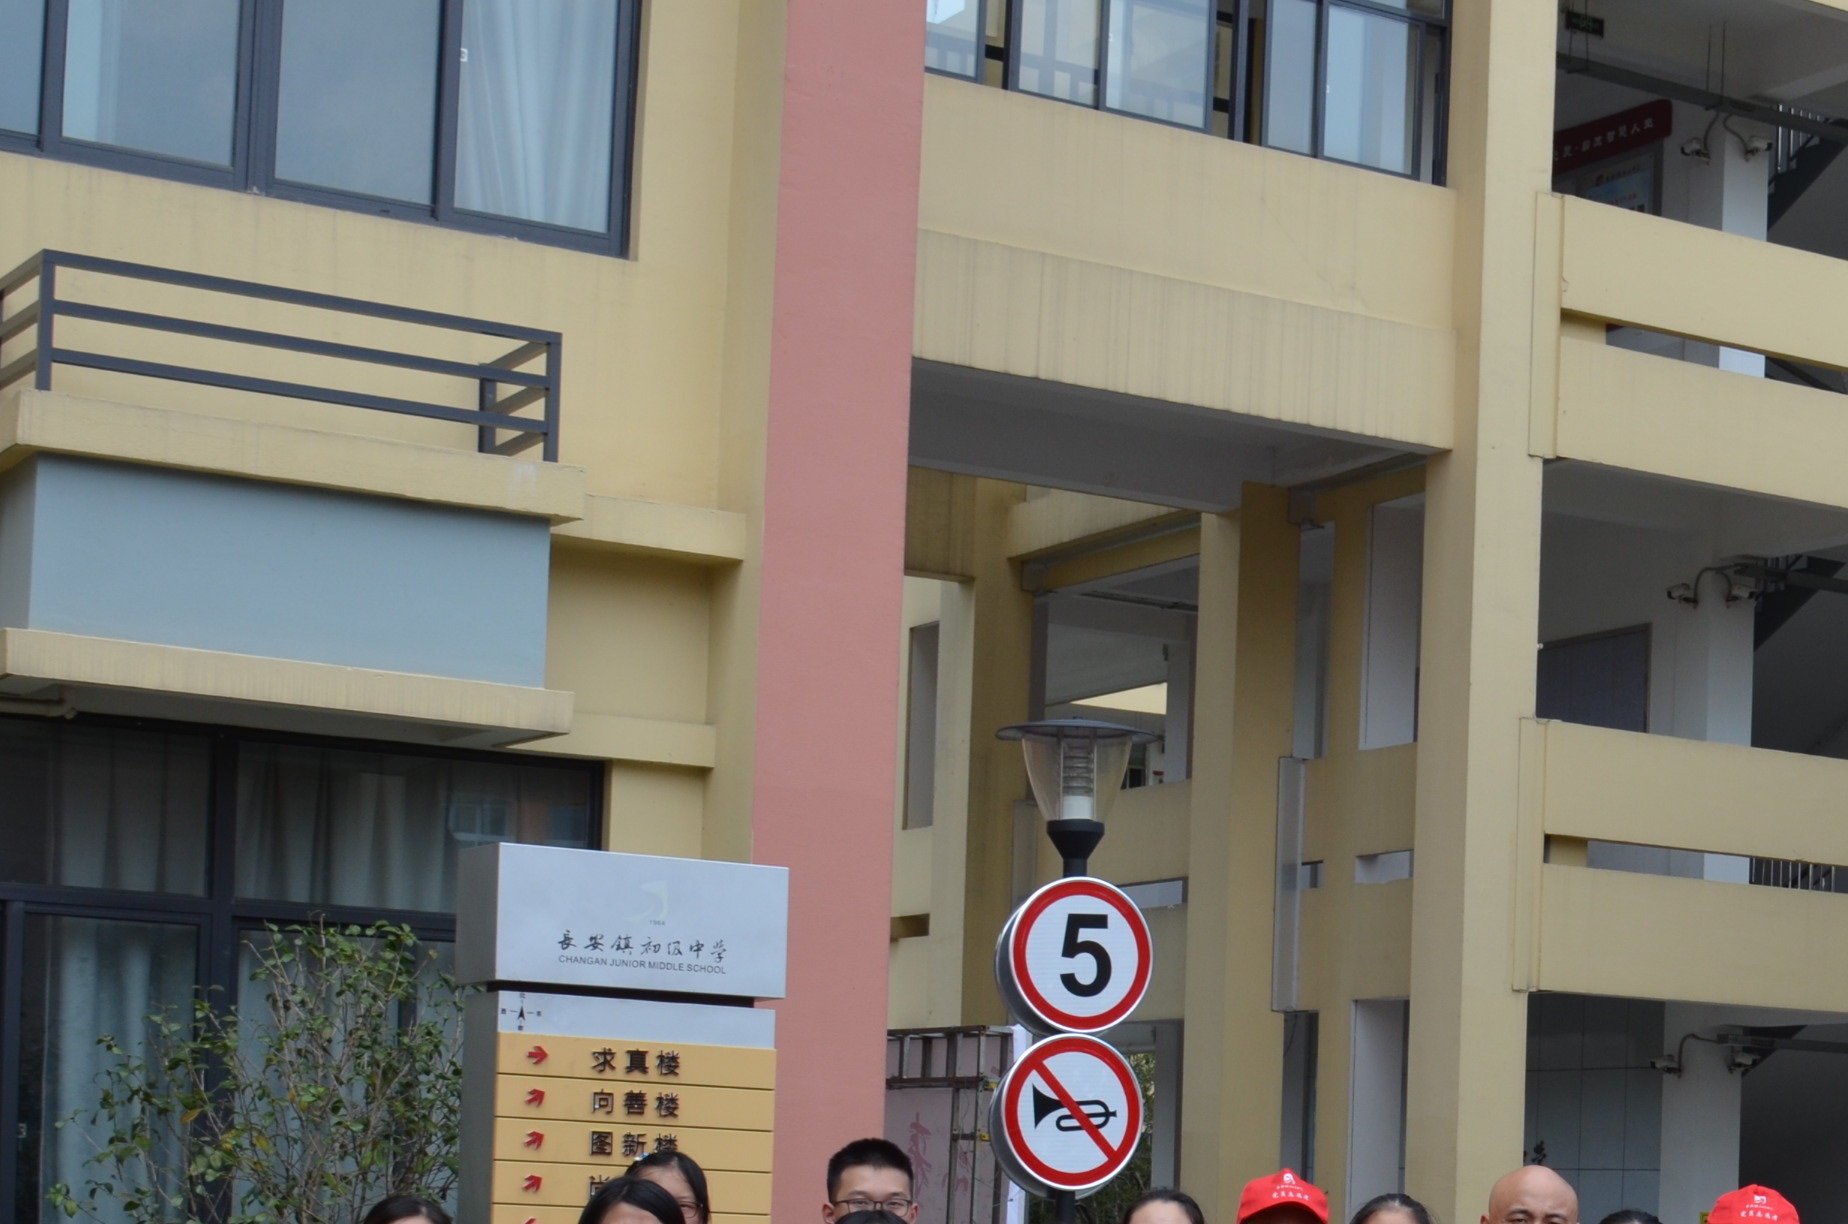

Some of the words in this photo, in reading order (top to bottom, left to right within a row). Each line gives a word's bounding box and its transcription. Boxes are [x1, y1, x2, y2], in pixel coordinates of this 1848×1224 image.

[558, 954, 608, 966] CHANGAN
[609, 959, 647, 969] JUNIOR
[648, 961, 684, 972] MIDDLE
[687, 964, 727, 975] SCHOOL
[1060, 913, 1112, 998] 5
[591, 1047, 681, 1077] 求真楼
[590, 1088, 680, 1119] 向善楼
